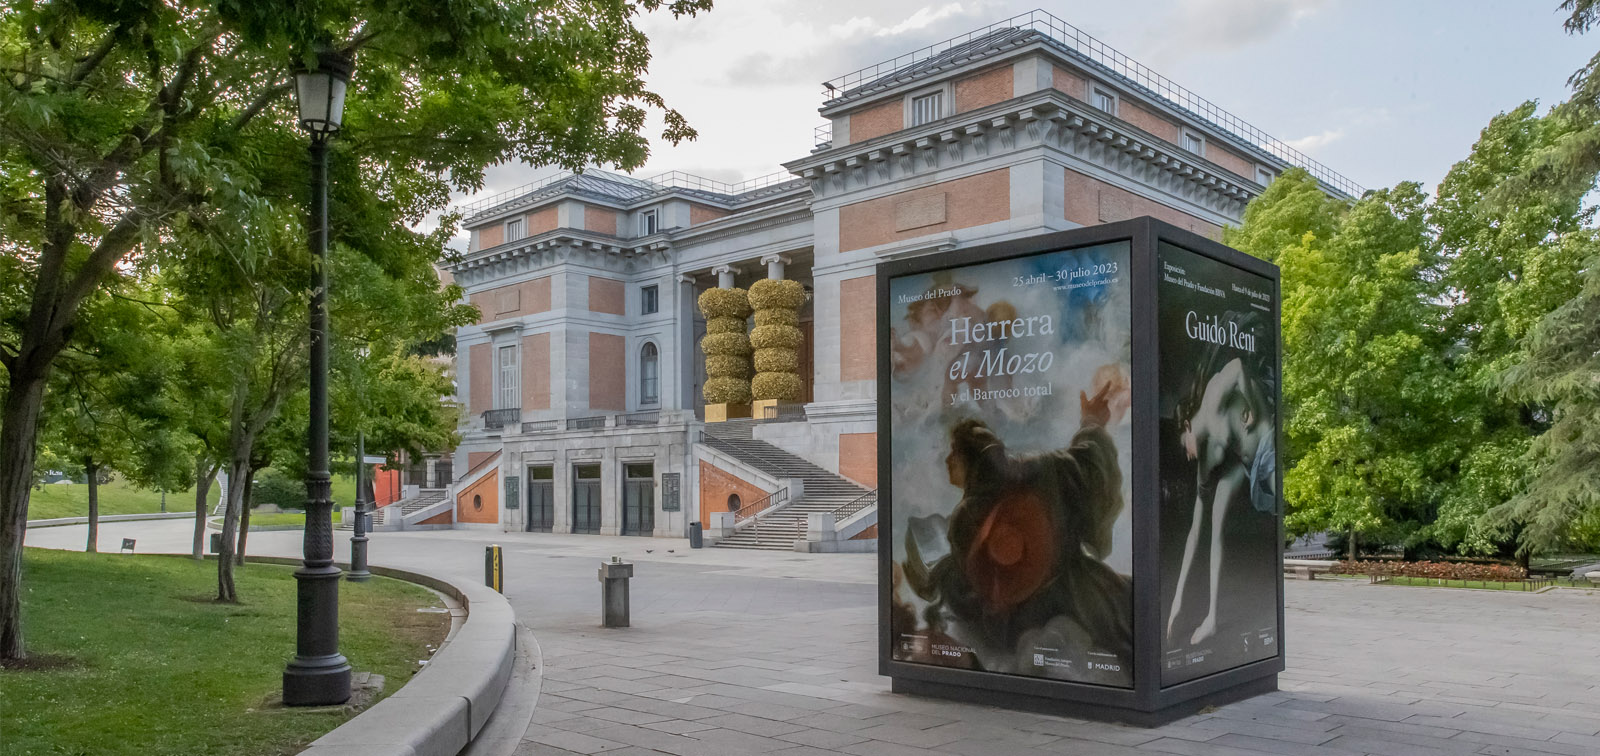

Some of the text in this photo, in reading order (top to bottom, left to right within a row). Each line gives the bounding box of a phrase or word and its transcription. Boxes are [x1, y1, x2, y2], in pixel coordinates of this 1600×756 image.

[1013, 276, 1024, 287] 25
[1025, 272, 1046, 285] abril
[1055, 270, 1068, 282] 30
[1069, 266, 1090, 281] julio
[1093, 262, 1118, 275] 2023
[1053, 277, 1119, 291] www.museodelprado.es
[898, 286, 962, 304] Museo del Prado
[949, 313, 1054, 346] Herrera
[1185, 310, 1255, 352] Guido Reni
[950, 348, 1053, 381] el Mozo
[950, 383, 1053, 405] y el Barroco total
[931, 643, 950, 651] MUSEO
[950, 645, 977, 654] NACIONAL
[1095, 663, 1121, 672] MADRID
